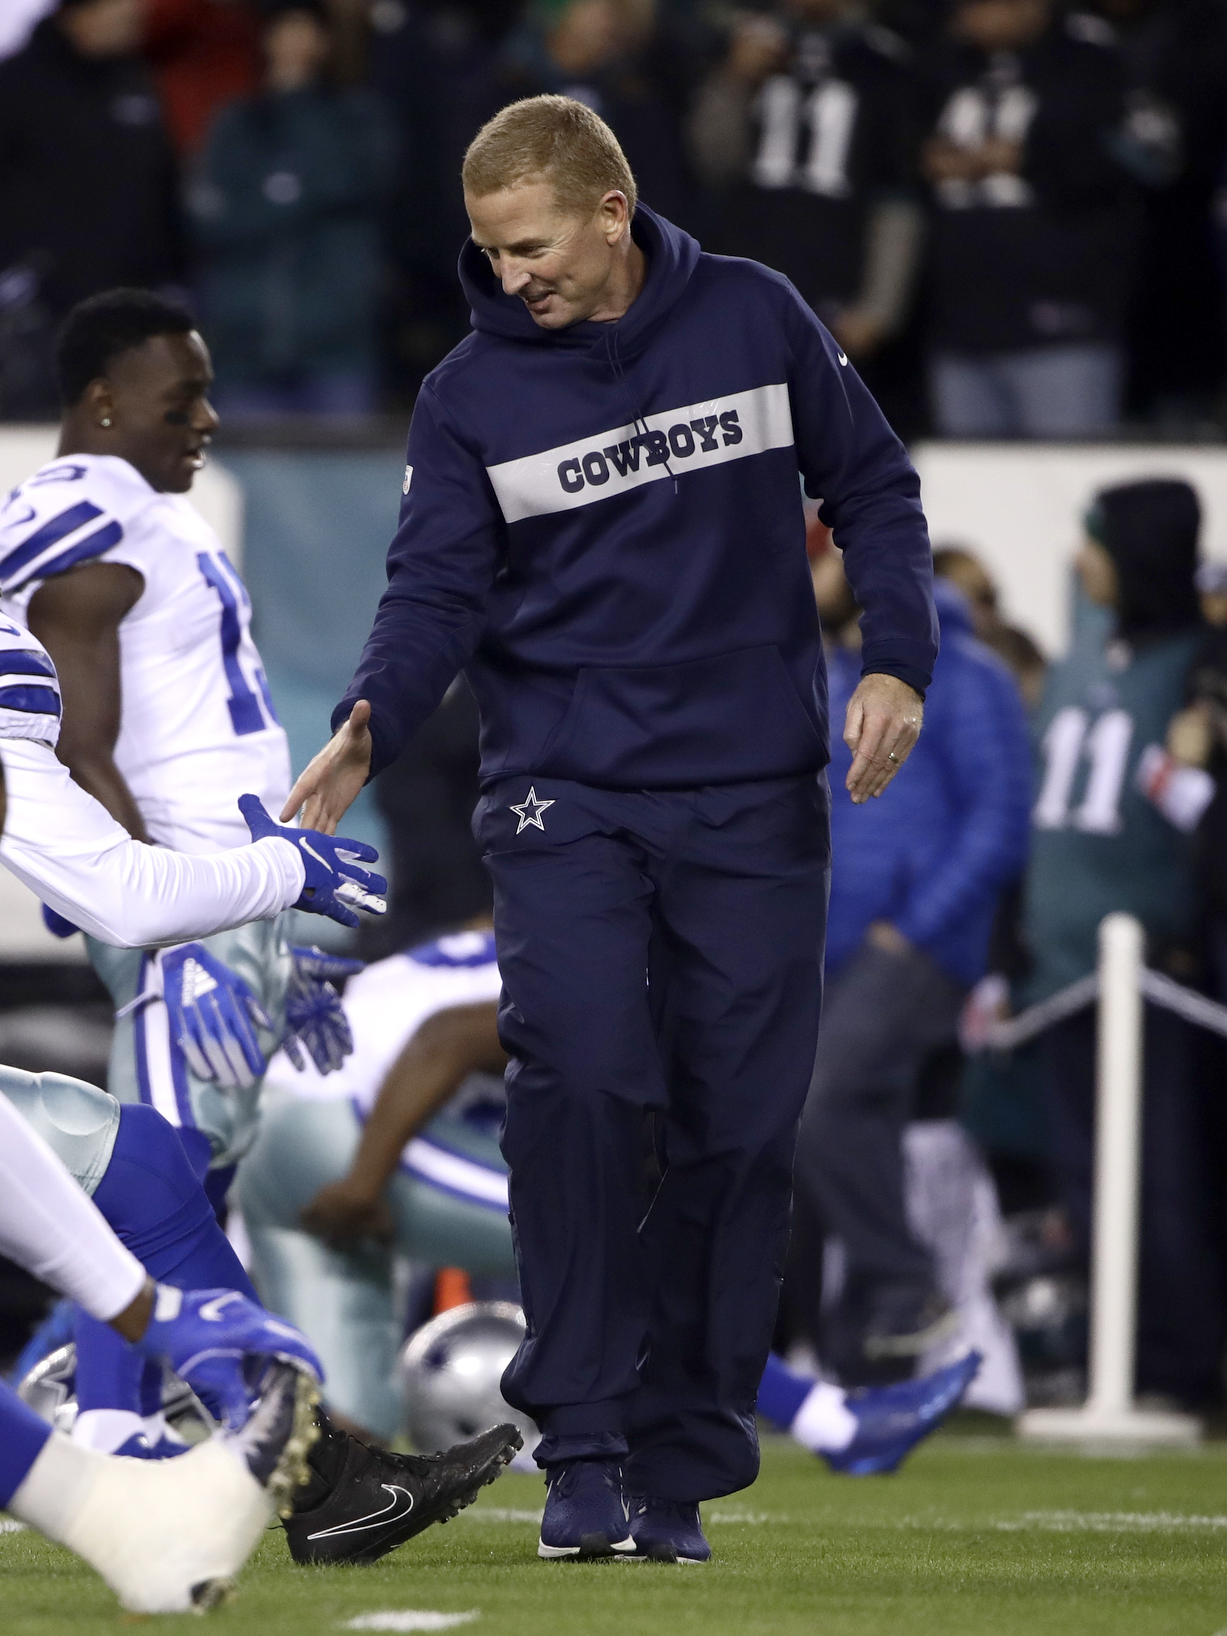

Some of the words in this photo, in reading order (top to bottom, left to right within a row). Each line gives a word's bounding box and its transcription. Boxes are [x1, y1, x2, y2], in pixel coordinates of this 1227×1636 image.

[757, 75, 857, 197] 11
[557, 409, 742, 493] COWBOYS
[1035, 706, 1134, 836] 11
